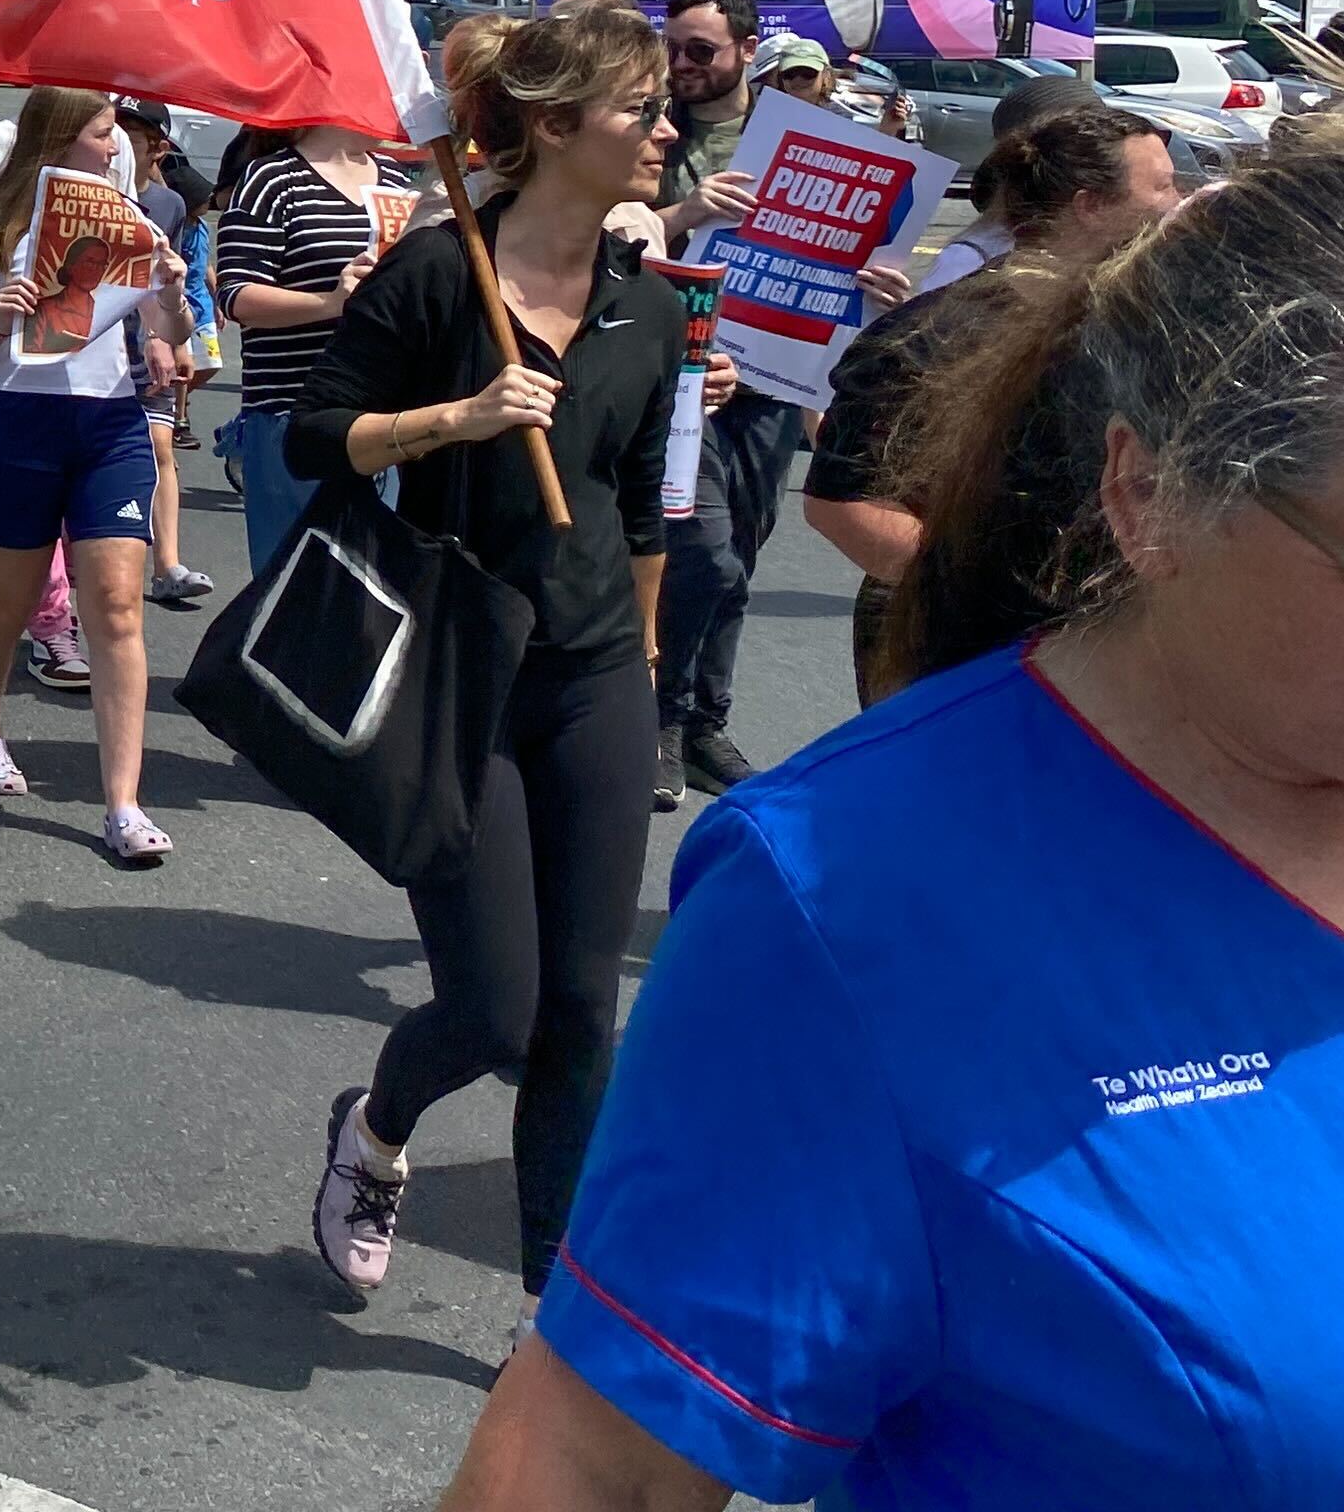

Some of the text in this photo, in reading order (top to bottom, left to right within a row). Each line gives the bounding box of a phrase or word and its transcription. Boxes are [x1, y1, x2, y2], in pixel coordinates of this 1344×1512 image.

[768, 15, 787, 25] get
[784, 144, 896, 186] STANDING FOR
[51, 197, 141, 224] AOTEARO
[53, 181, 122, 204] WORKERS
[766, 166, 882, 225] PUBLIC
[59, 217, 137, 246] UNITE
[751, 207, 864, 254] EDUCATION
[751, 250, 771, 270] TE
[754, 276, 802, 307] NGĀ
[798, 288, 850, 318] KURA
[1092, 1051, 1272, 1097] Te Whatu Ora
[1106, 1075, 1264, 1116] Health New Zealand
